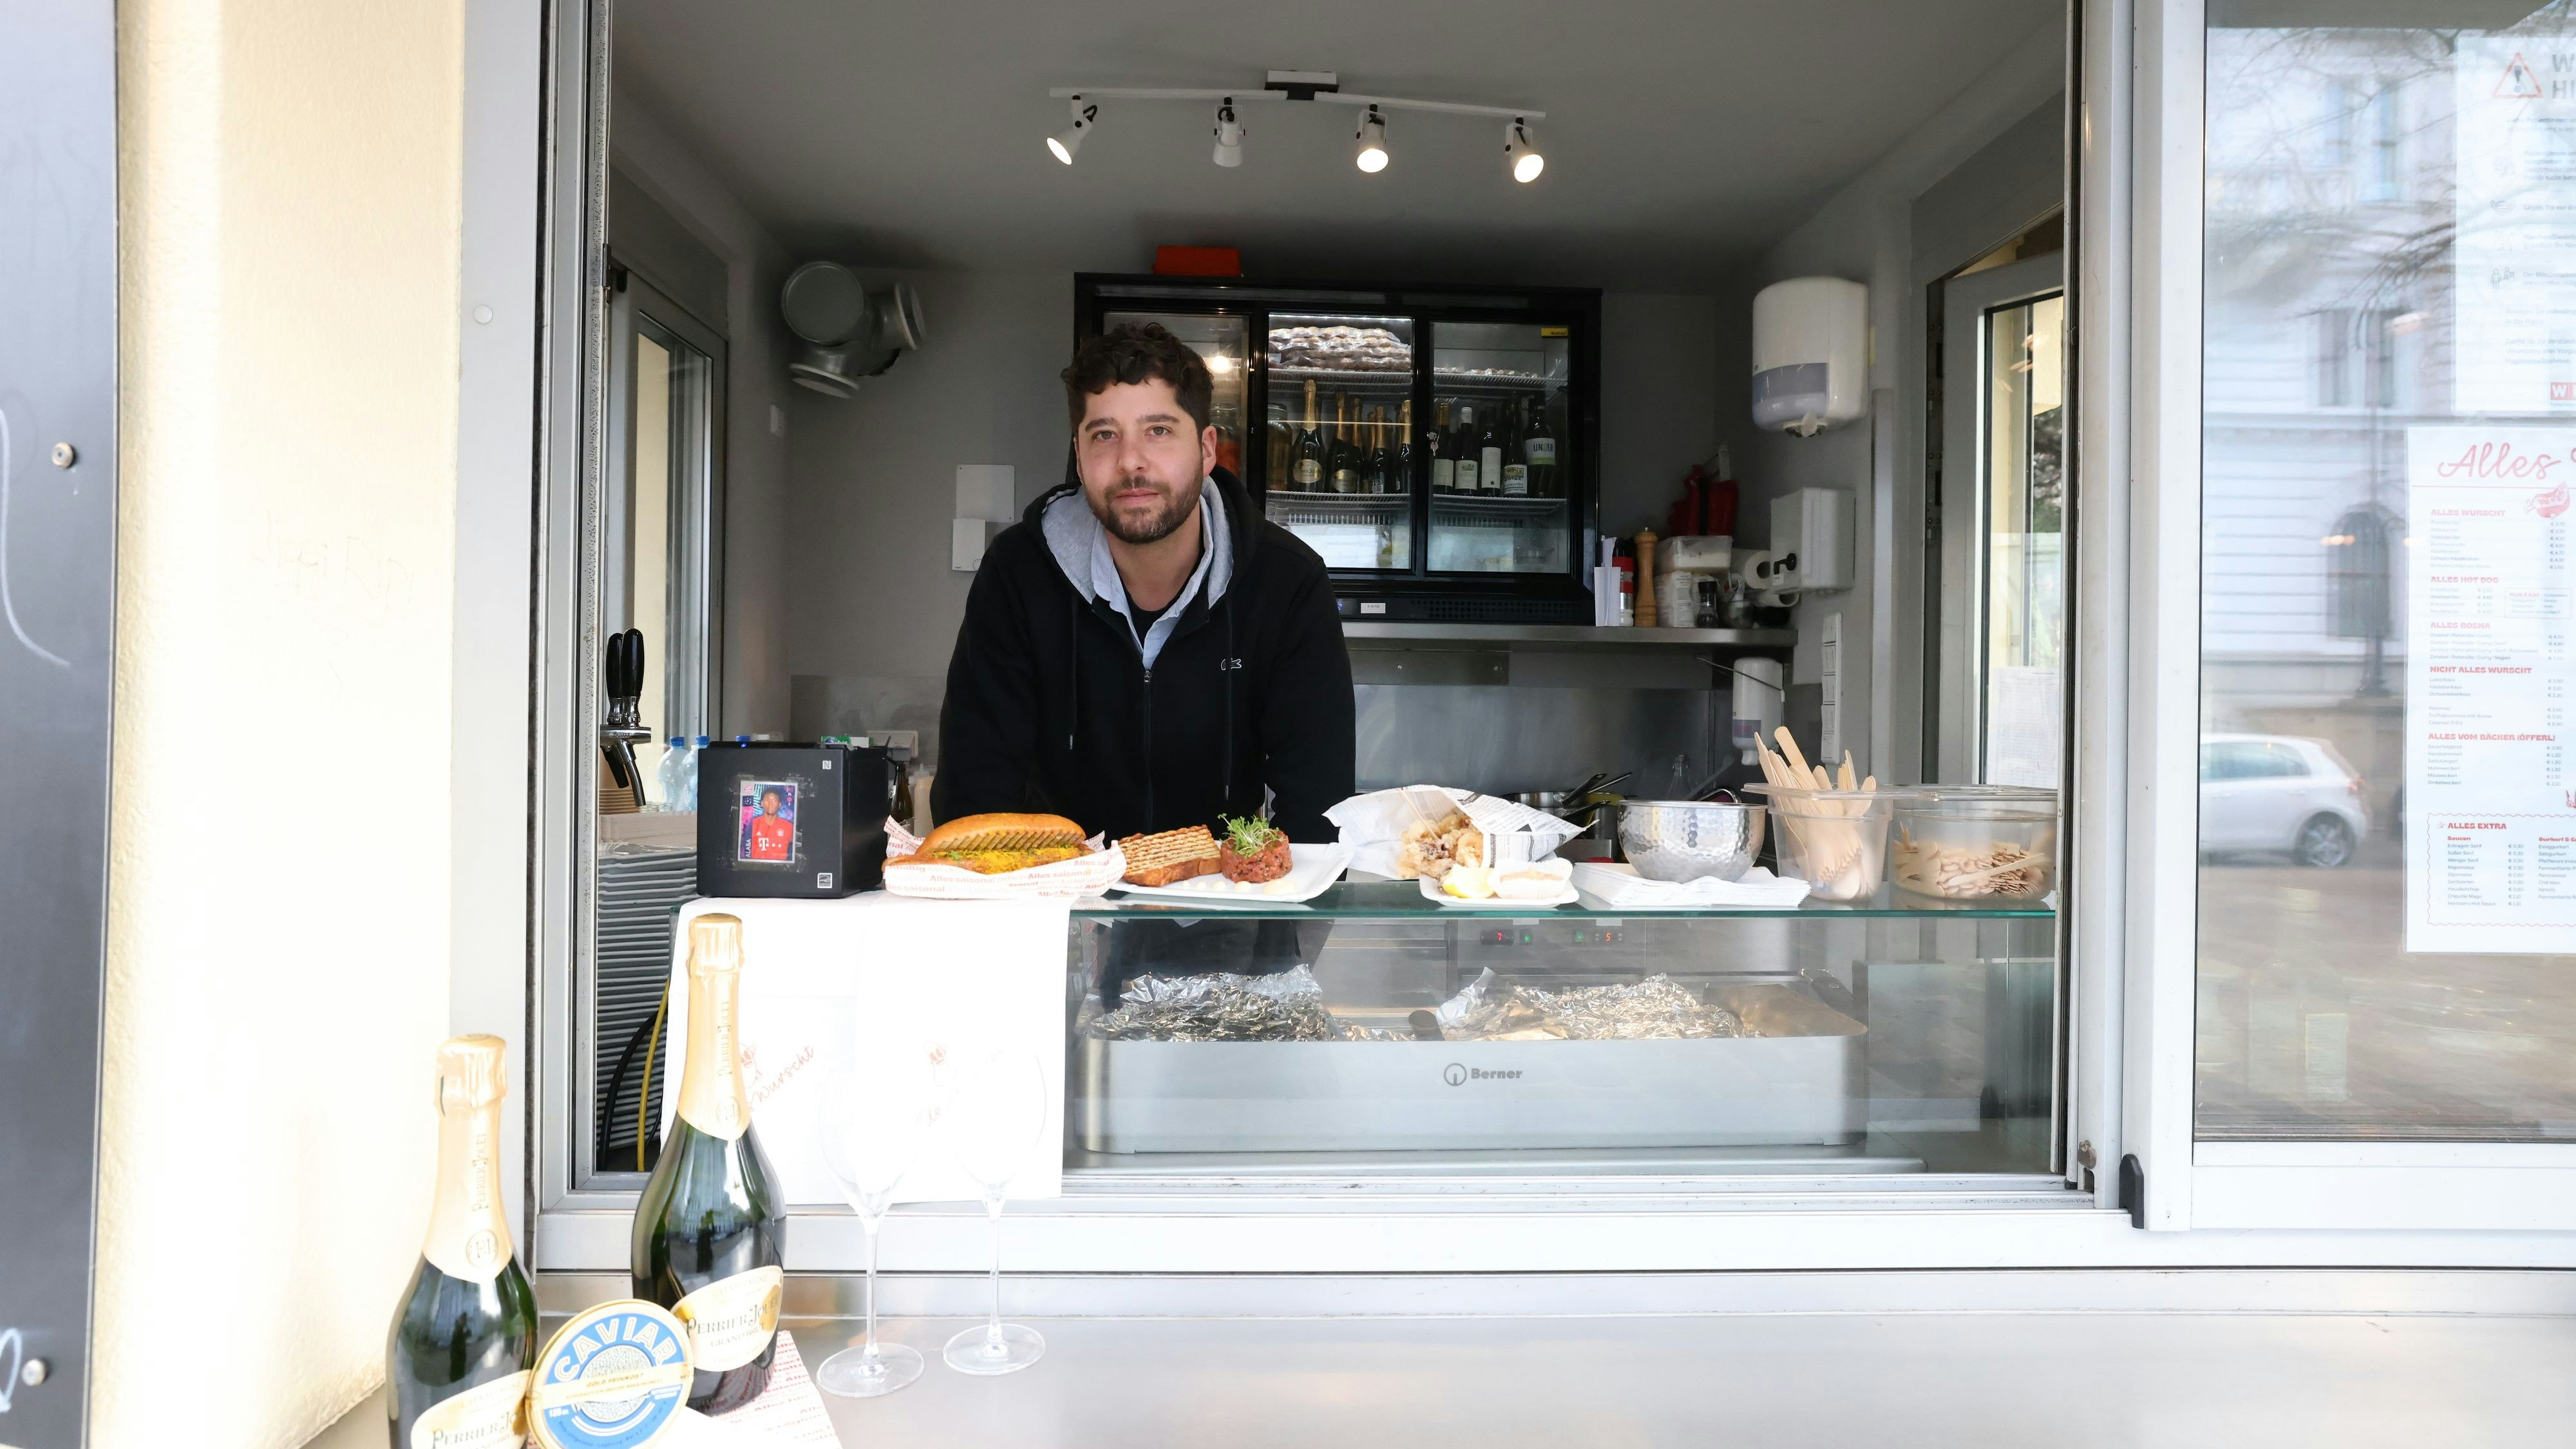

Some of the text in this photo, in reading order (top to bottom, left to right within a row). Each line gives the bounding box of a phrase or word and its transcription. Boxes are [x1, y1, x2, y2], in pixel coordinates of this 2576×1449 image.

[2438, 442, 2561, 480] Alles
[1052, 869, 1092, 877] saisonal
[752, 1045, 814, 1103] Wurscht
[1471, 1068, 1522, 1079] Berner
[554, 1316, 677, 1383] CAVIAR
